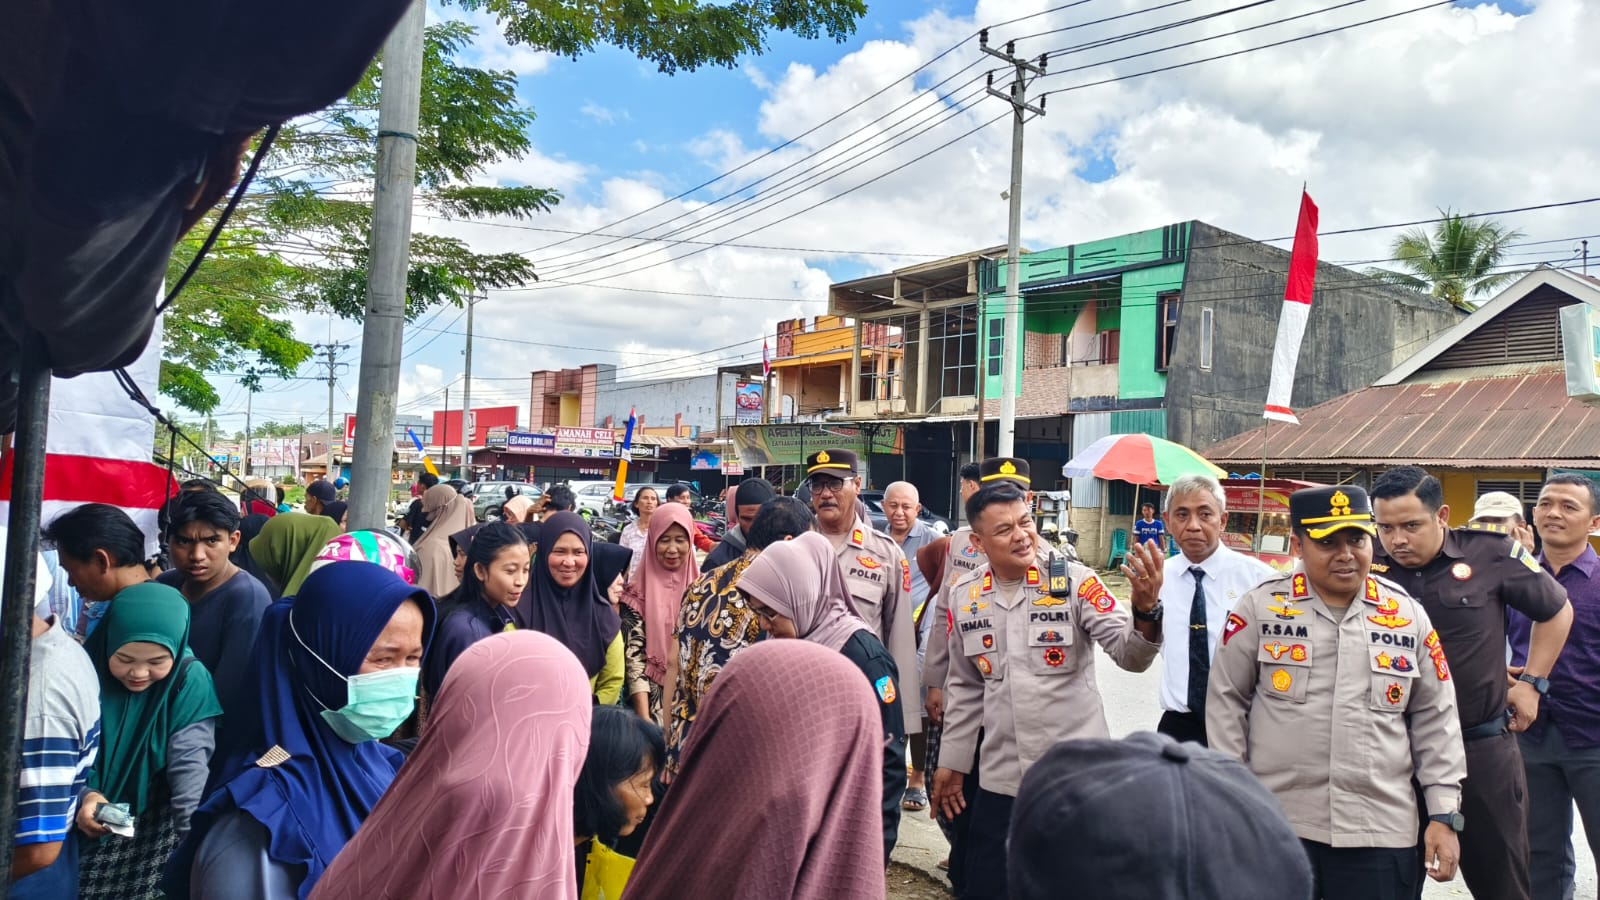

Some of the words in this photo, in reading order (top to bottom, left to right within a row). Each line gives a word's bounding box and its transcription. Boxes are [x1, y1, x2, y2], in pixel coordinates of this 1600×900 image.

[557, 429, 592, 439] AMANAH
[594, 430, 613, 440] CELL
[849, 567, 882, 582] POLRI
[1050, 576, 1067, 590] K3
[1030, 612, 1069, 622] POLRI
[960, 619, 992, 632] ISMAIL
[1262, 623, 1308, 638] F.SAM
[1371, 631, 1415, 649] POLRI
